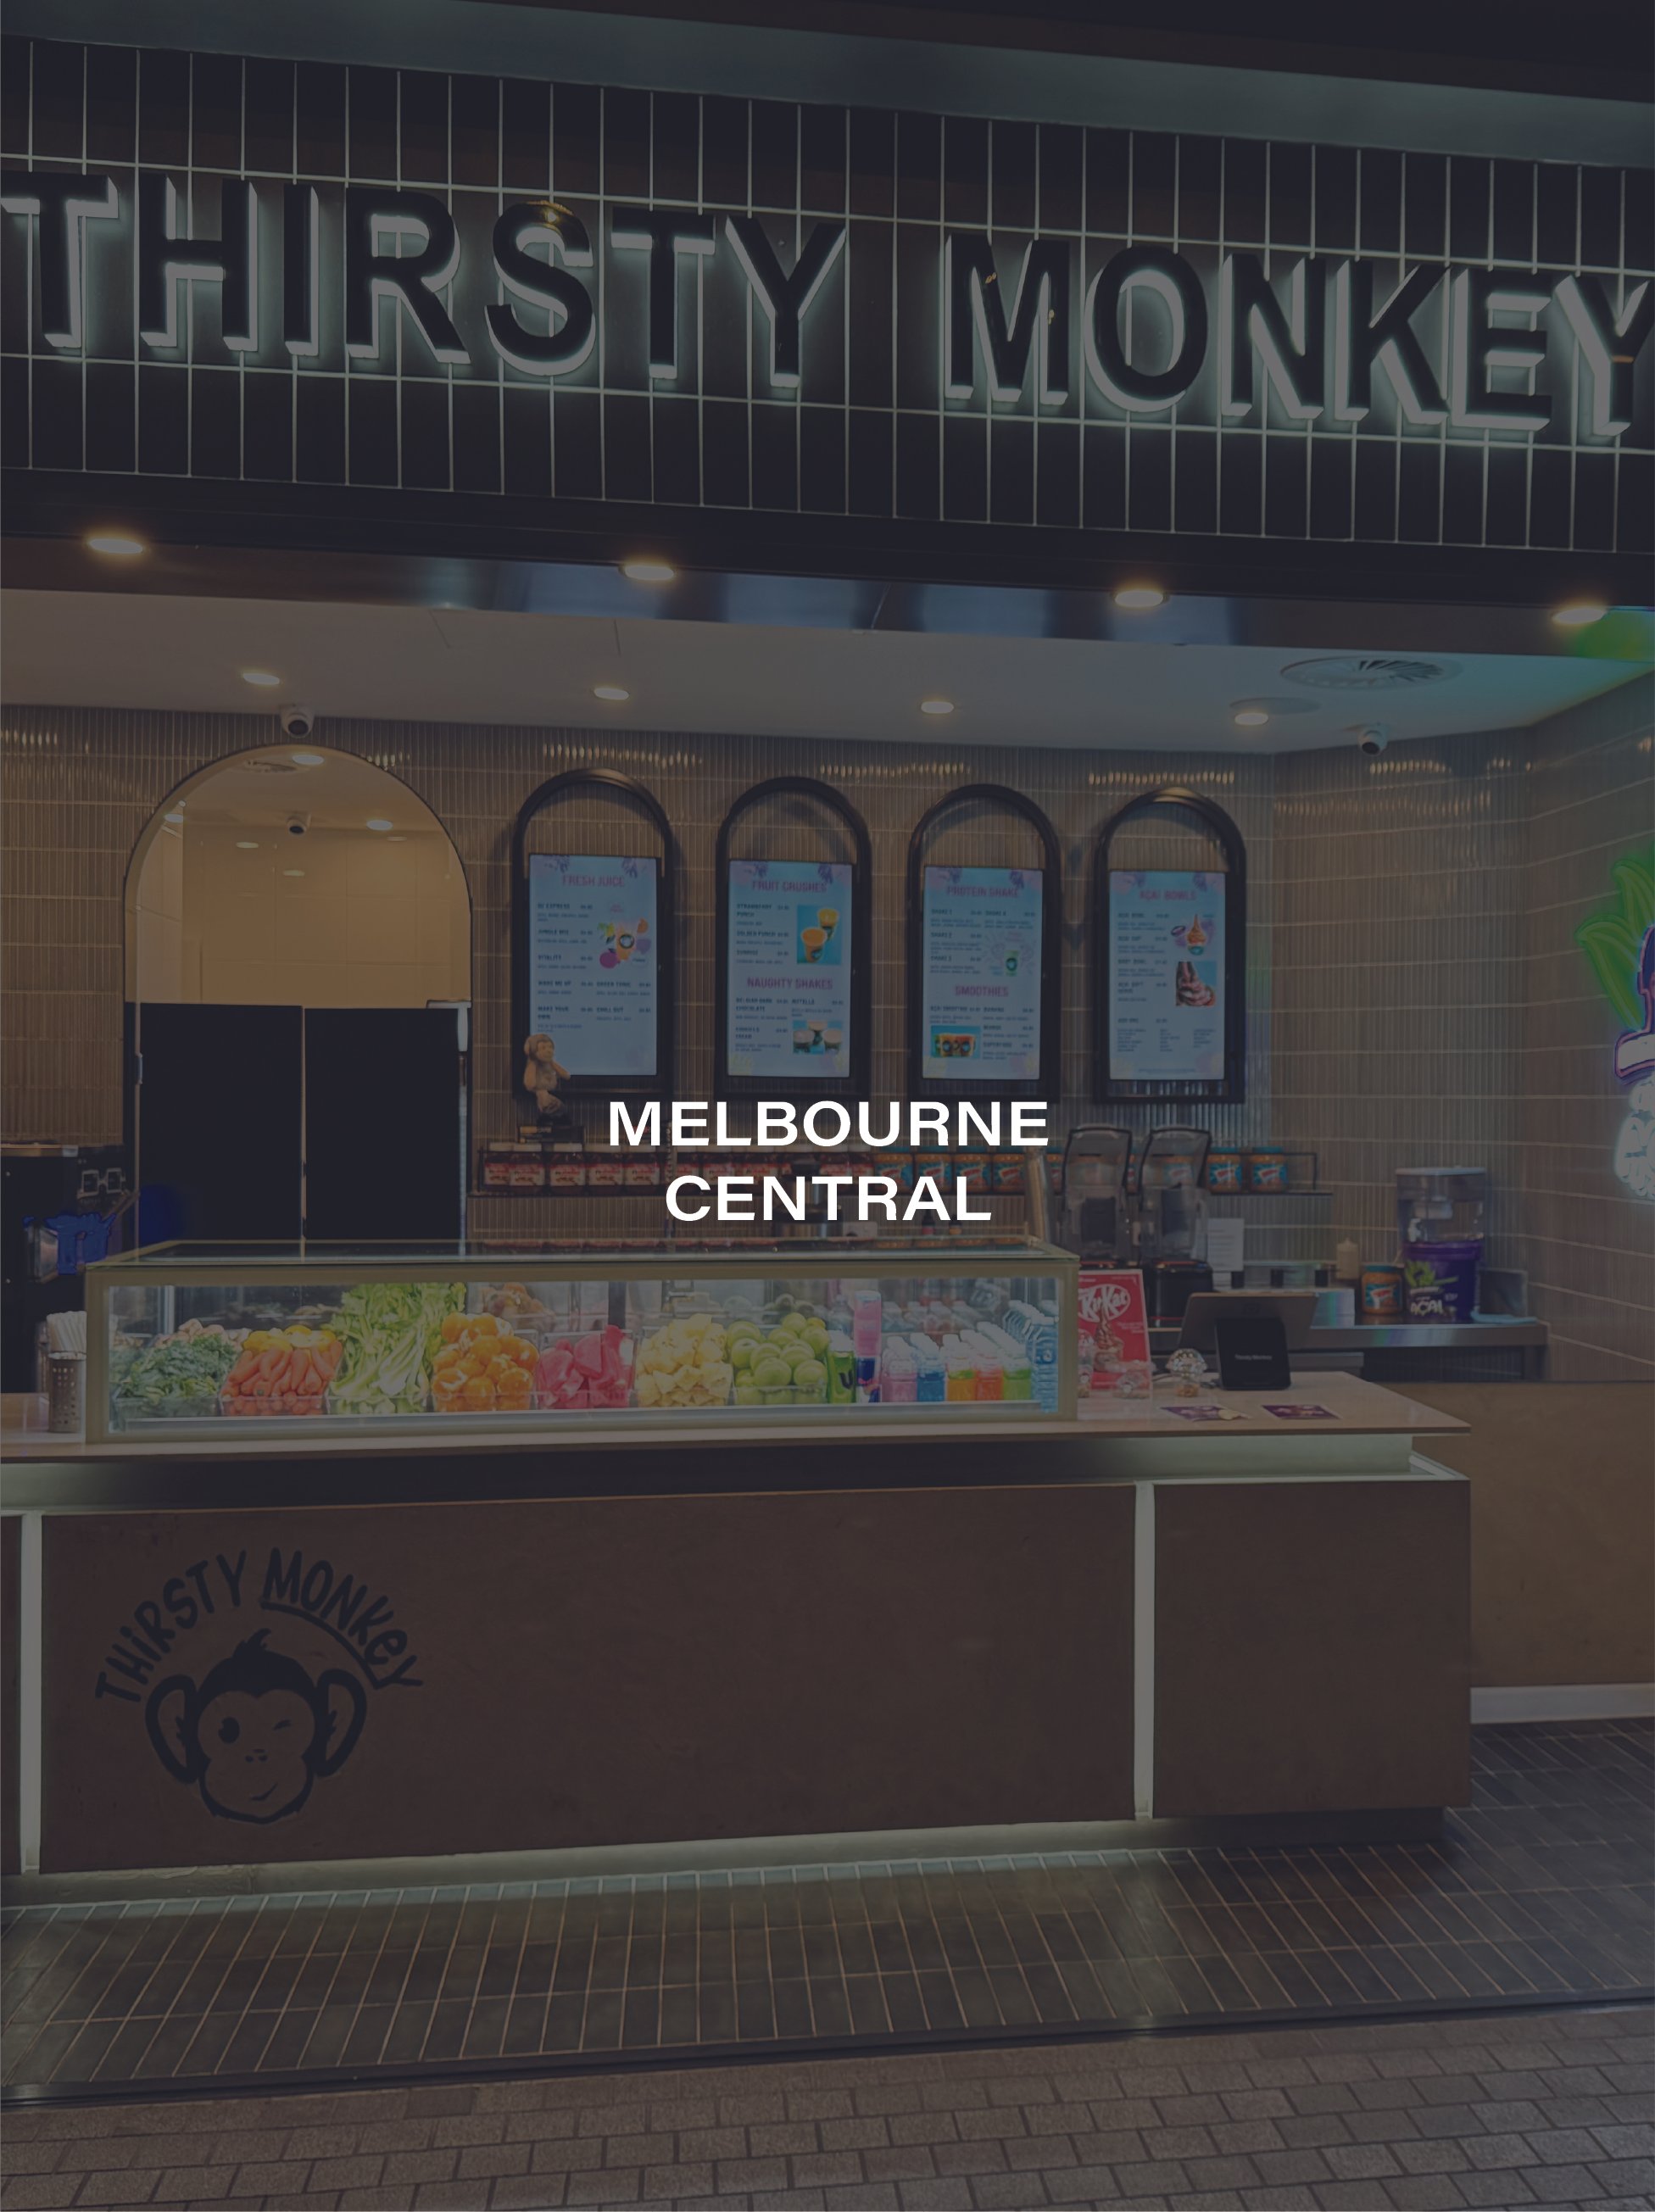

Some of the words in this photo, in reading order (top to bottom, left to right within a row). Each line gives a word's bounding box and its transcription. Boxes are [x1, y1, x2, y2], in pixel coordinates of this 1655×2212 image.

[0, 173, 847, 387] THIRSTY
[944, 232, 1655, 437] MONKEY
[562, 874, 595, 887] FRESH
[598, 875, 625, 888] JUICE
[752, 881, 780, 892] FRUIT
[783, 882, 828, 893] CRUSHES
[947, 886, 987, 897] PROTEIN
[1164, 890, 1196, 900] BOWLS
[747, 977, 793, 989] NAUGHTY
[795, 978, 833, 990] SHAKES
[955, 985, 1009, 997] SMOOTHIES
[1080, 1285, 1129, 1321] KitKat
